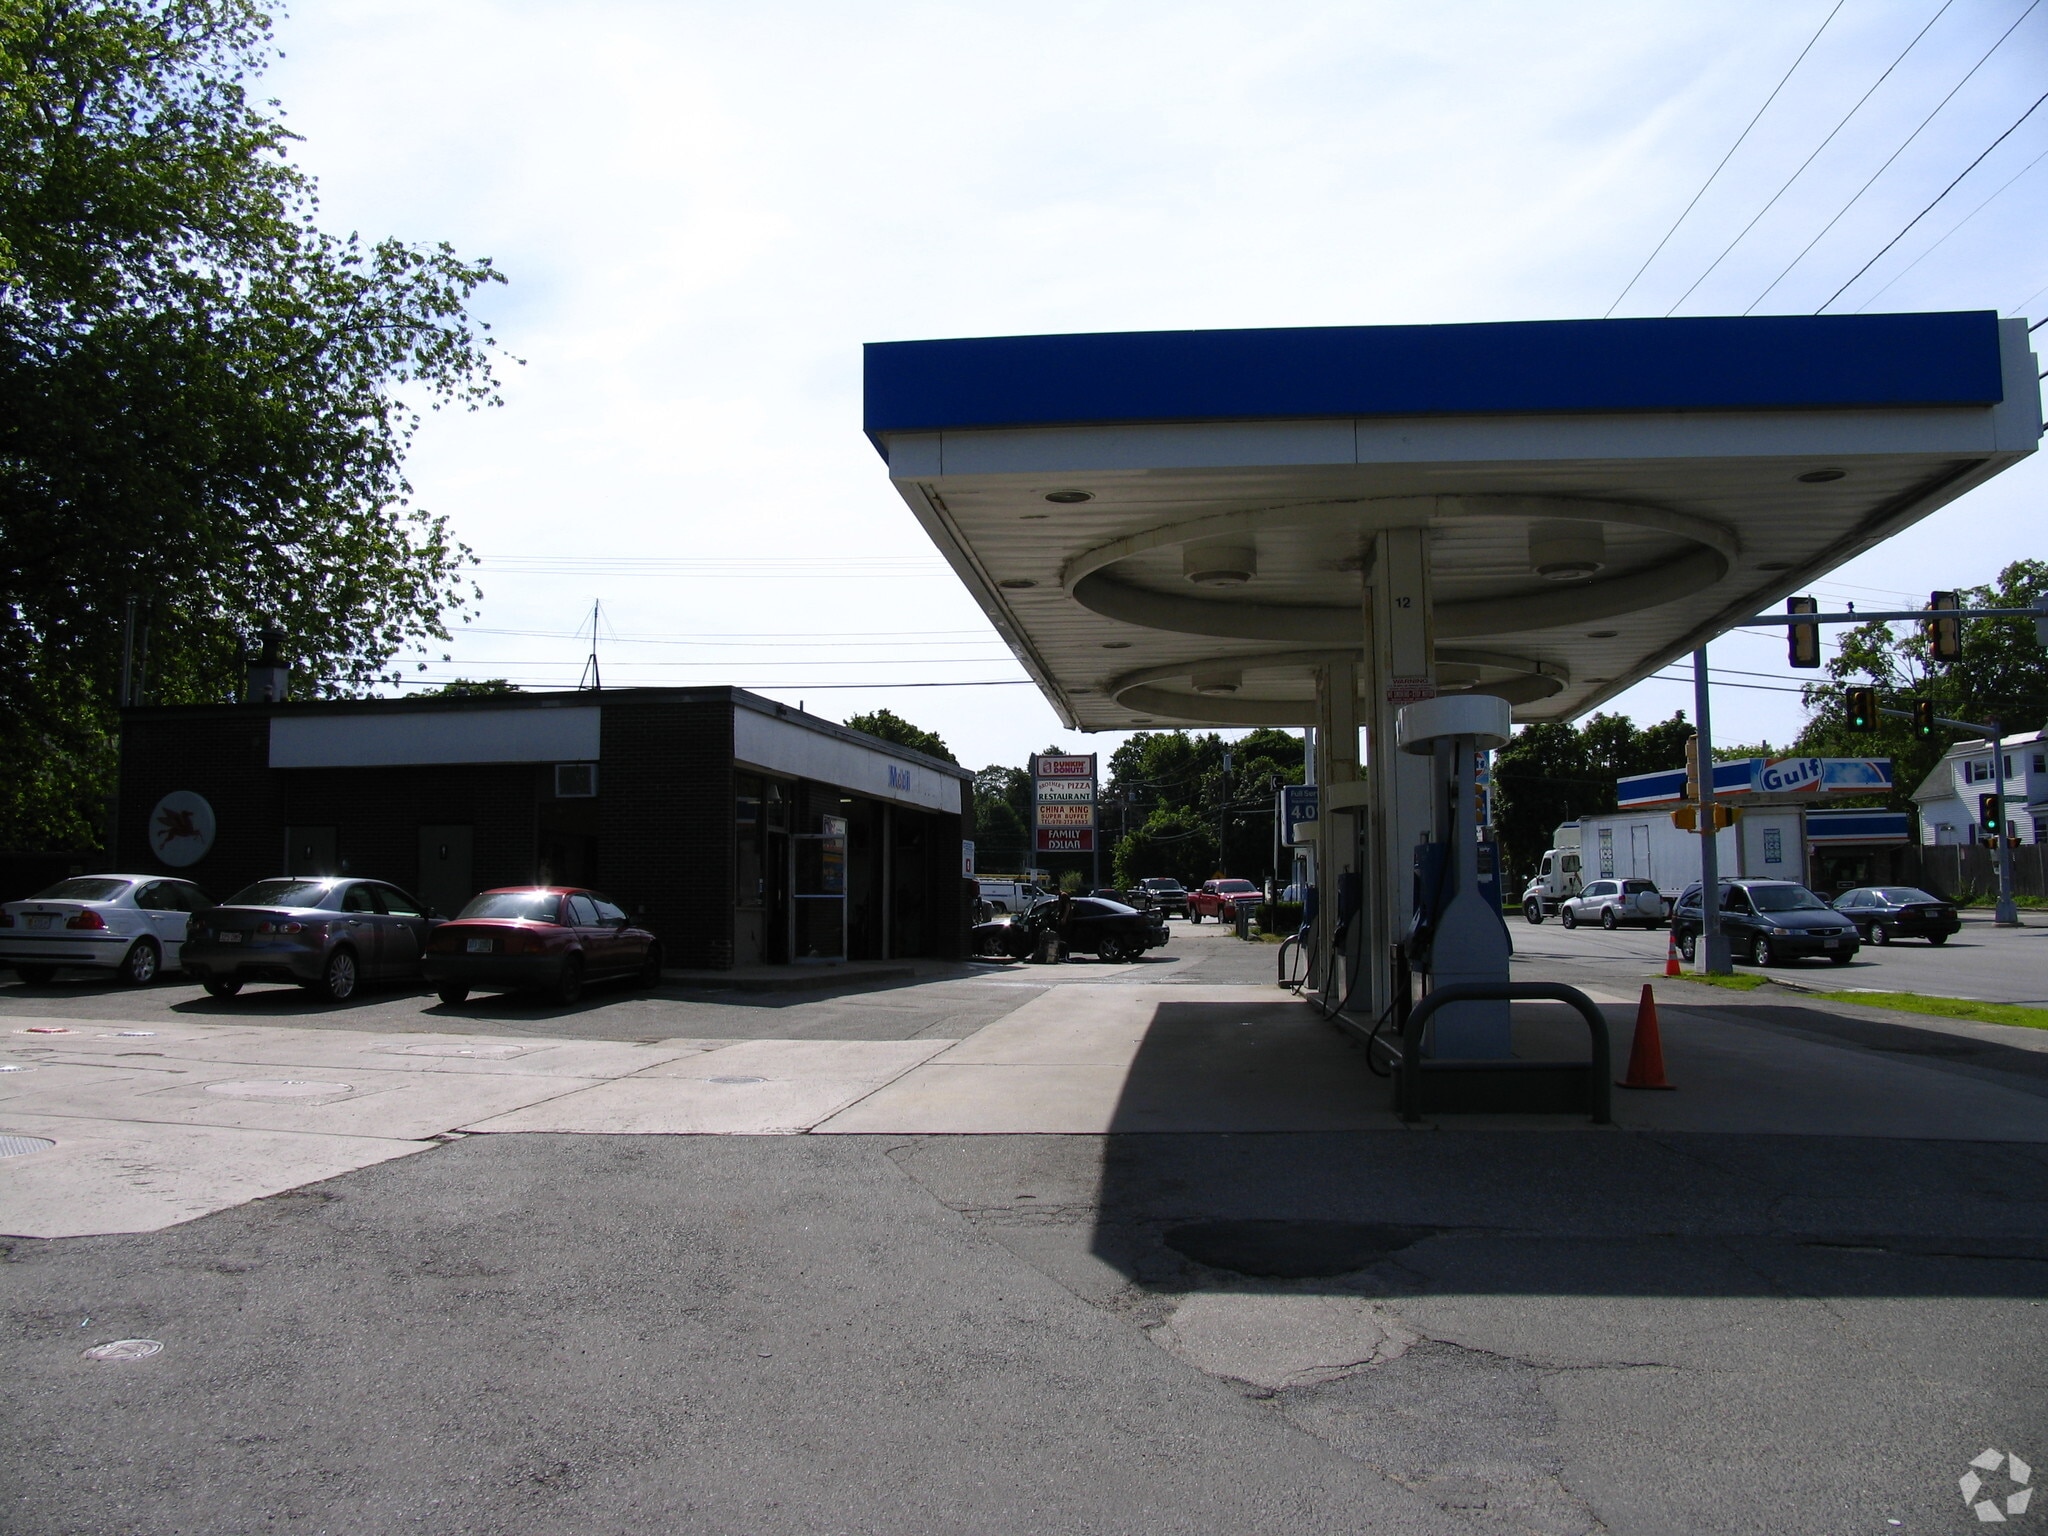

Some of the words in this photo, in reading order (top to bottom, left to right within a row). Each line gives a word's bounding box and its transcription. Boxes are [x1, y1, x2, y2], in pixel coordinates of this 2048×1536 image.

[1396, 597, 1411, 608] 12
[1763, 758, 1819, 790] Gulf
[1067, 782, 1090, 790] PIZZA
[1040, 805, 1065, 813] CHINA
[1070, 805, 1089, 813] KING
[1291, 805, 1317, 819] 4.0
[1049, 829, 1081, 839] FAMILY
[1049, 840, 1081, 849] DOLLAR
